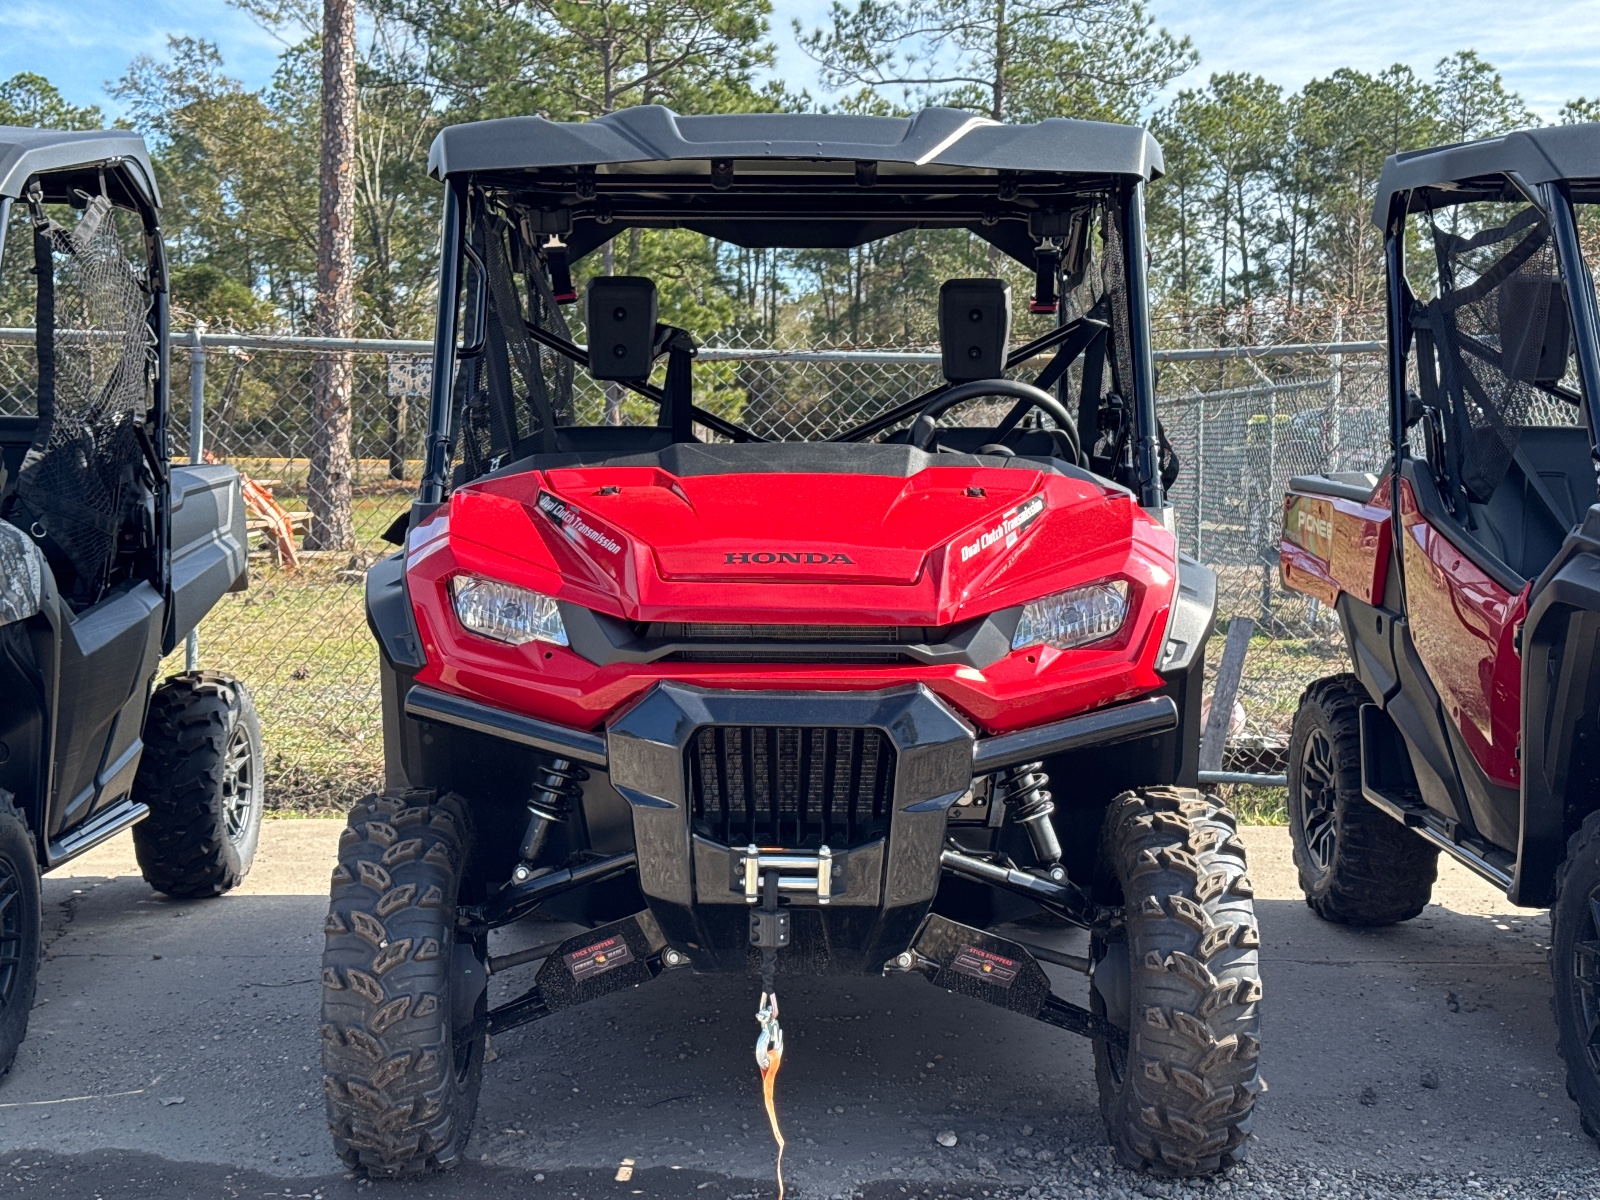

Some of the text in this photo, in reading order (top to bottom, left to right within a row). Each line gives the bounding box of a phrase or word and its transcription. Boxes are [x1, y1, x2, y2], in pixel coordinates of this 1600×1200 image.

[540, 496, 621, 554] Dual Clutch Transmission
[961, 539, 980, 562] Dual
[980, 524, 1004, 550] Clutch
[1002, 500, 1043, 534] Transmission
[1298, 511, 1332, 541] PIONEE
[724, 552, 856, 565] HONDA
[571, 939, 615, 960] STICK STOPPERS
[969, 947, 985, 958] STICK
[985, 952, 1013, 966] STOPPERS
